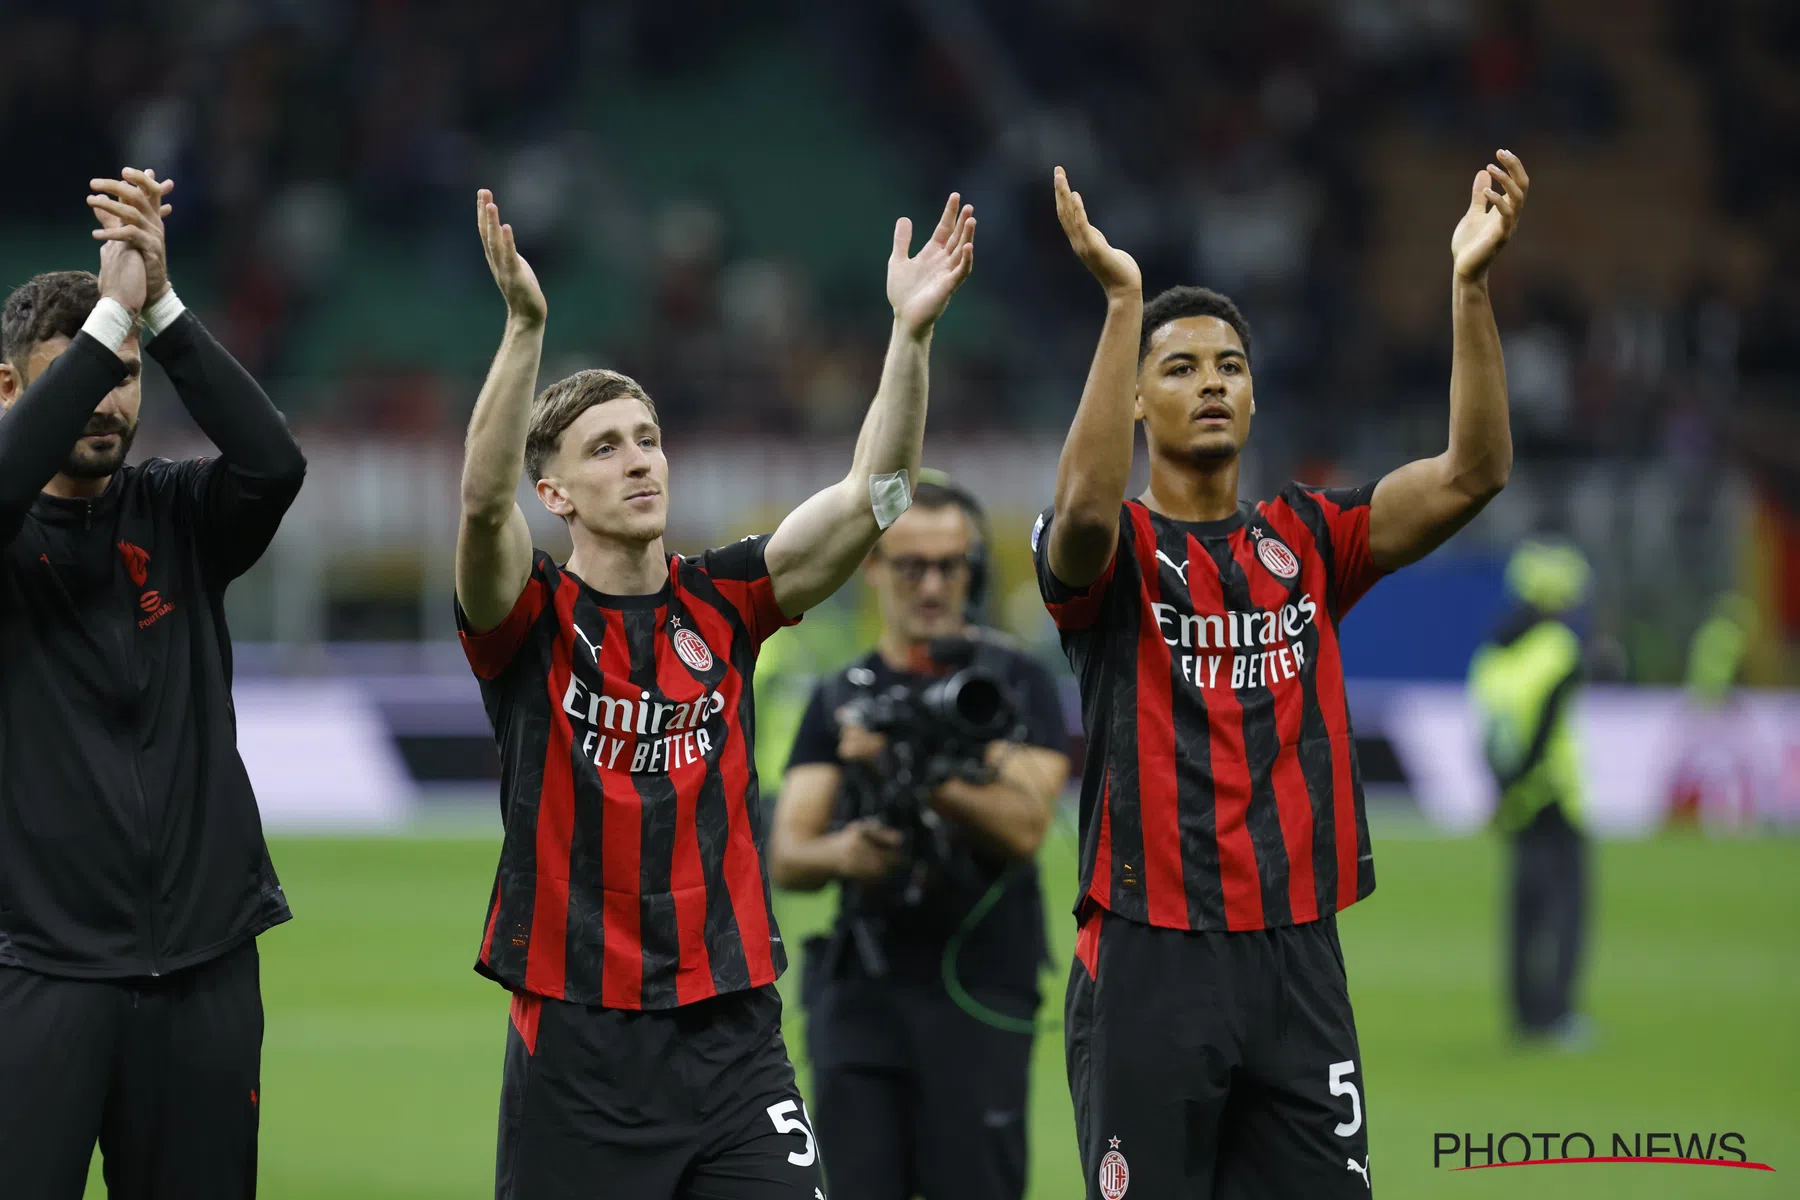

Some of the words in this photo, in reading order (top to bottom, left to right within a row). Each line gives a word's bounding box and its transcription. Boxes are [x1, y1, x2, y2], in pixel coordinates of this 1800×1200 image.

[1181, 655, 1222, 688] FLY
[1231, 641, 1305, 689] BETTER
[582, 730, 626, 770] FLY
[629, 728, 713, 773] BETTER
[1328, 1059, 1362, 1138] 5
[766, 1099, 821, 1167] 5
